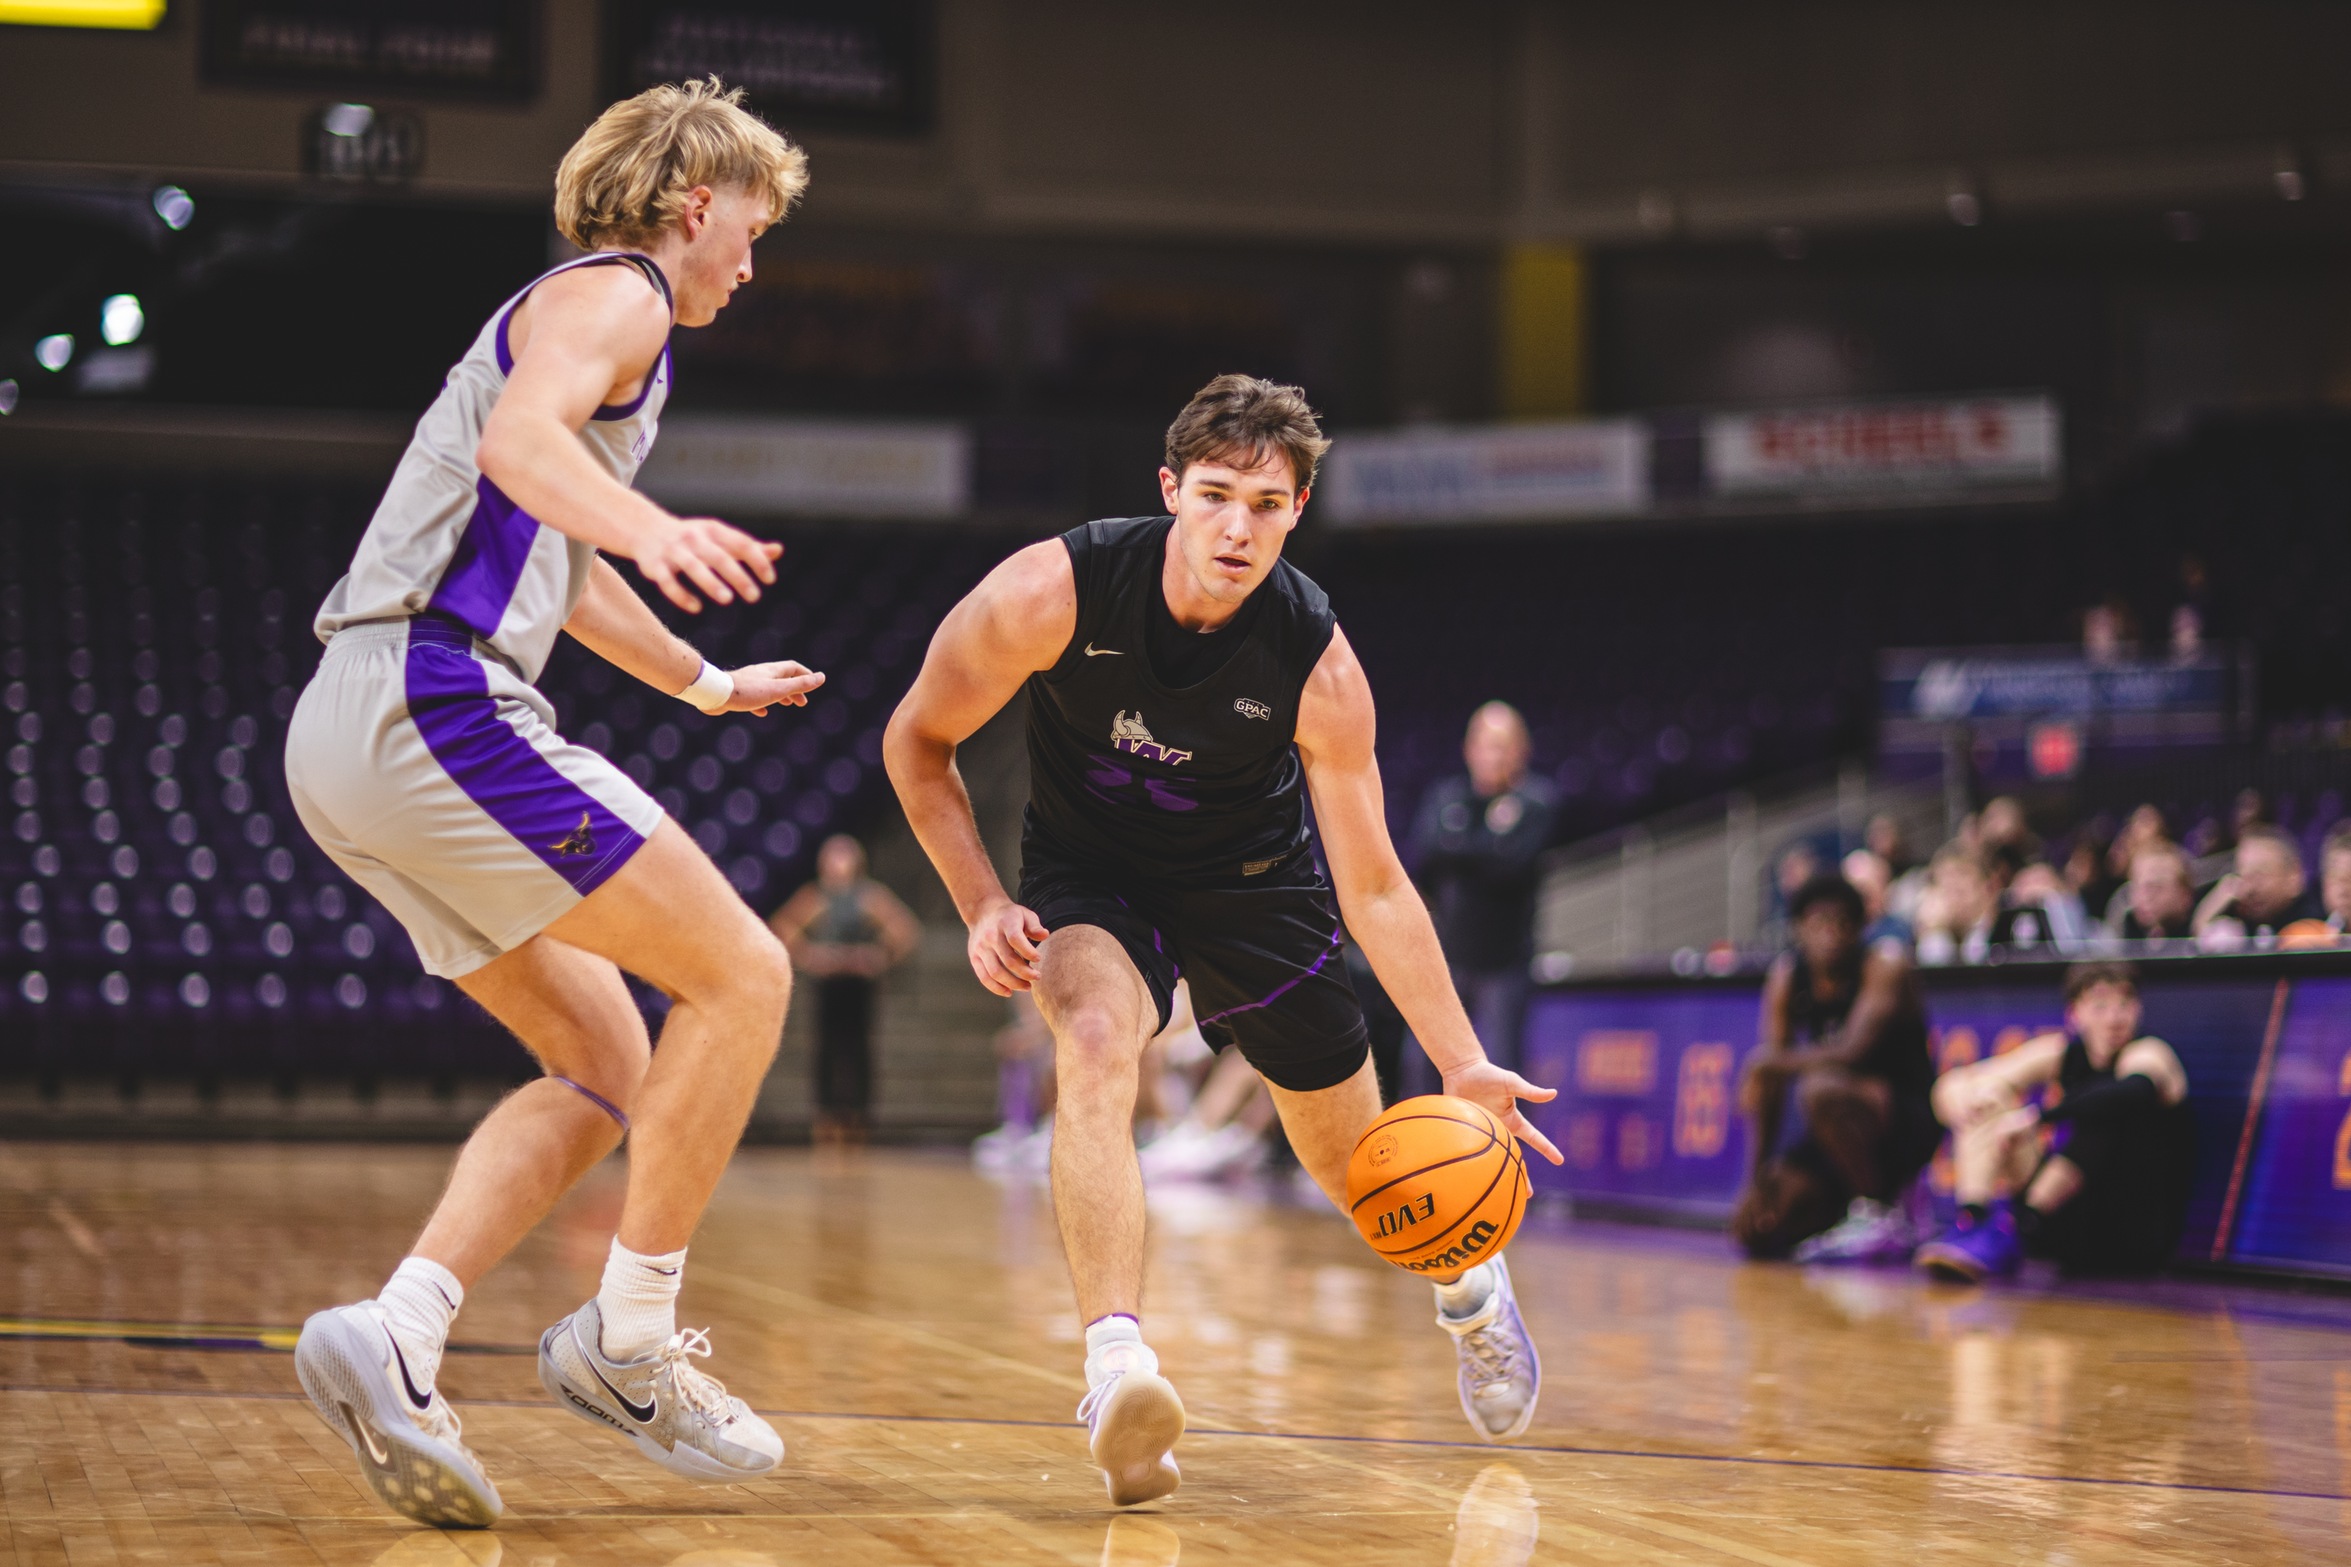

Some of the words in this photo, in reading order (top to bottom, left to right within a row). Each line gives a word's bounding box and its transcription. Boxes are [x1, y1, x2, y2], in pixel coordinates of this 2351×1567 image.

[1236, 700, 1269, 718] GPAC
[1378, 1192, 1435, 1237] EVO
[1389, 1219, 1499, 1271] Wilson
